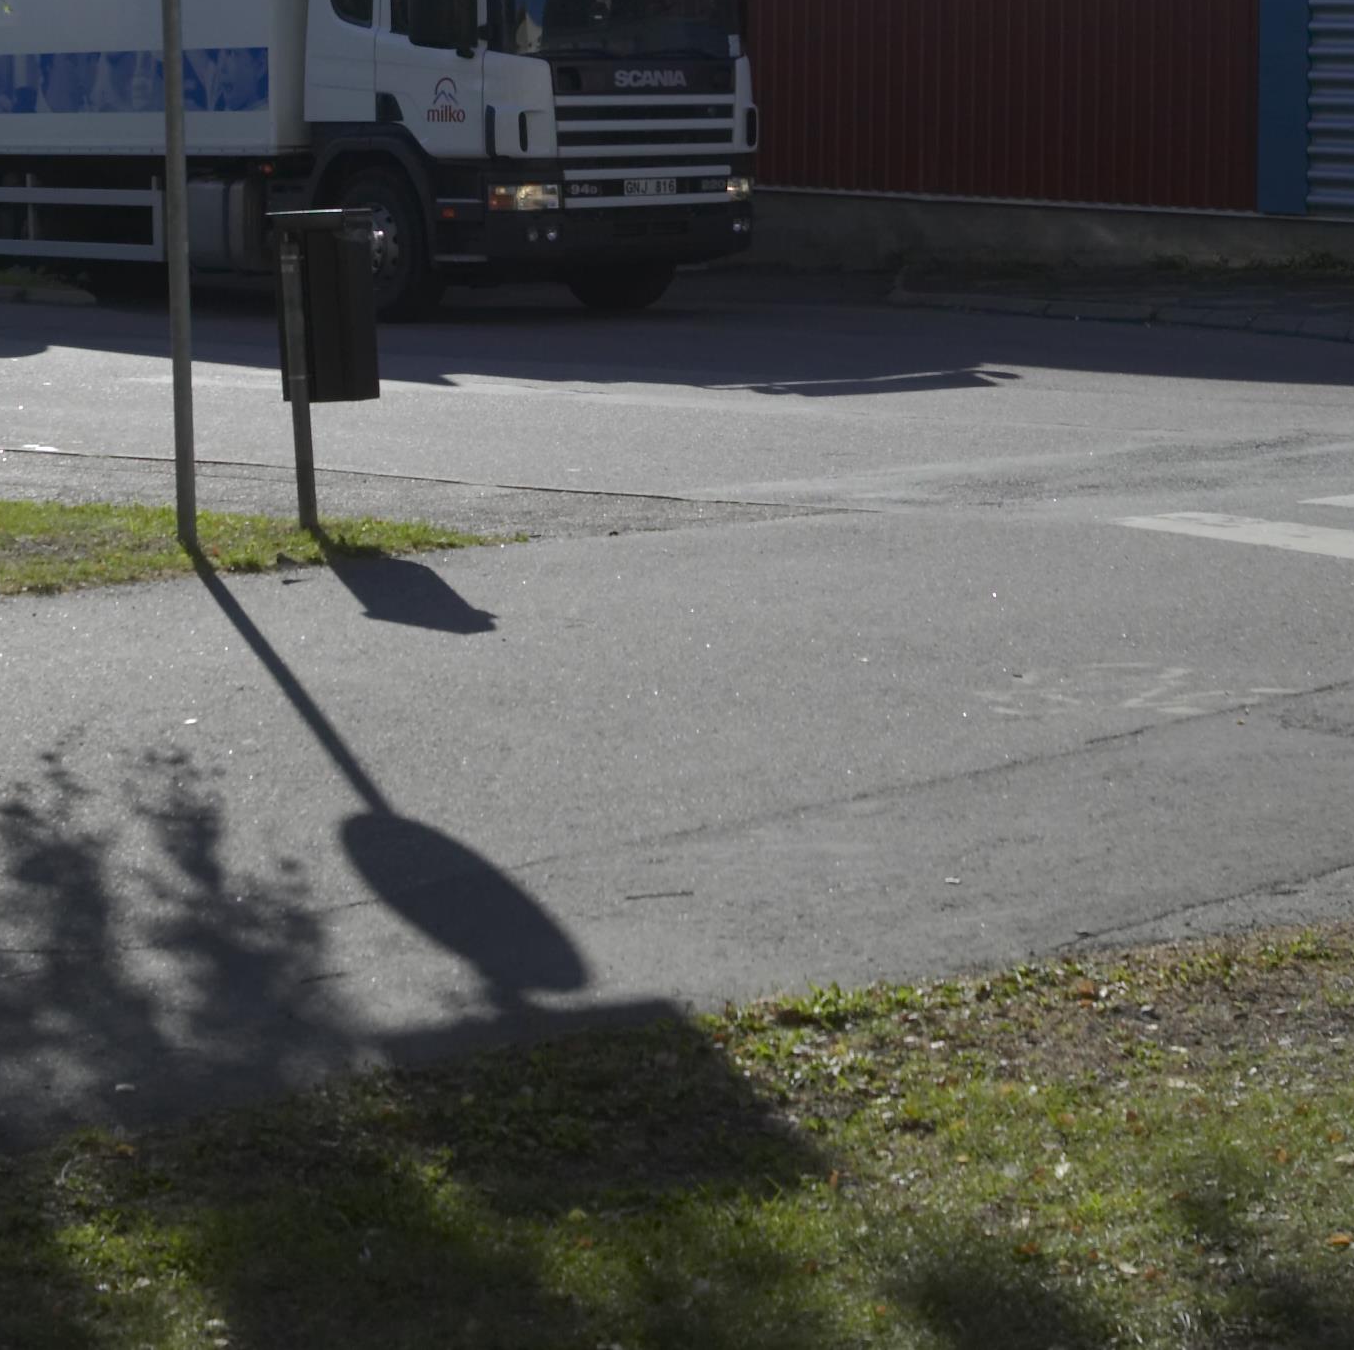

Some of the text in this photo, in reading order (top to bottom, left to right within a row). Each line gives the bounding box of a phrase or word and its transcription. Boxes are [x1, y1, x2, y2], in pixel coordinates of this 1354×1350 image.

[614, 69, 687, 88] SCANIA
[426, 104, 466, 123] milko
[625, 179, 675, 195] GNJ 816
